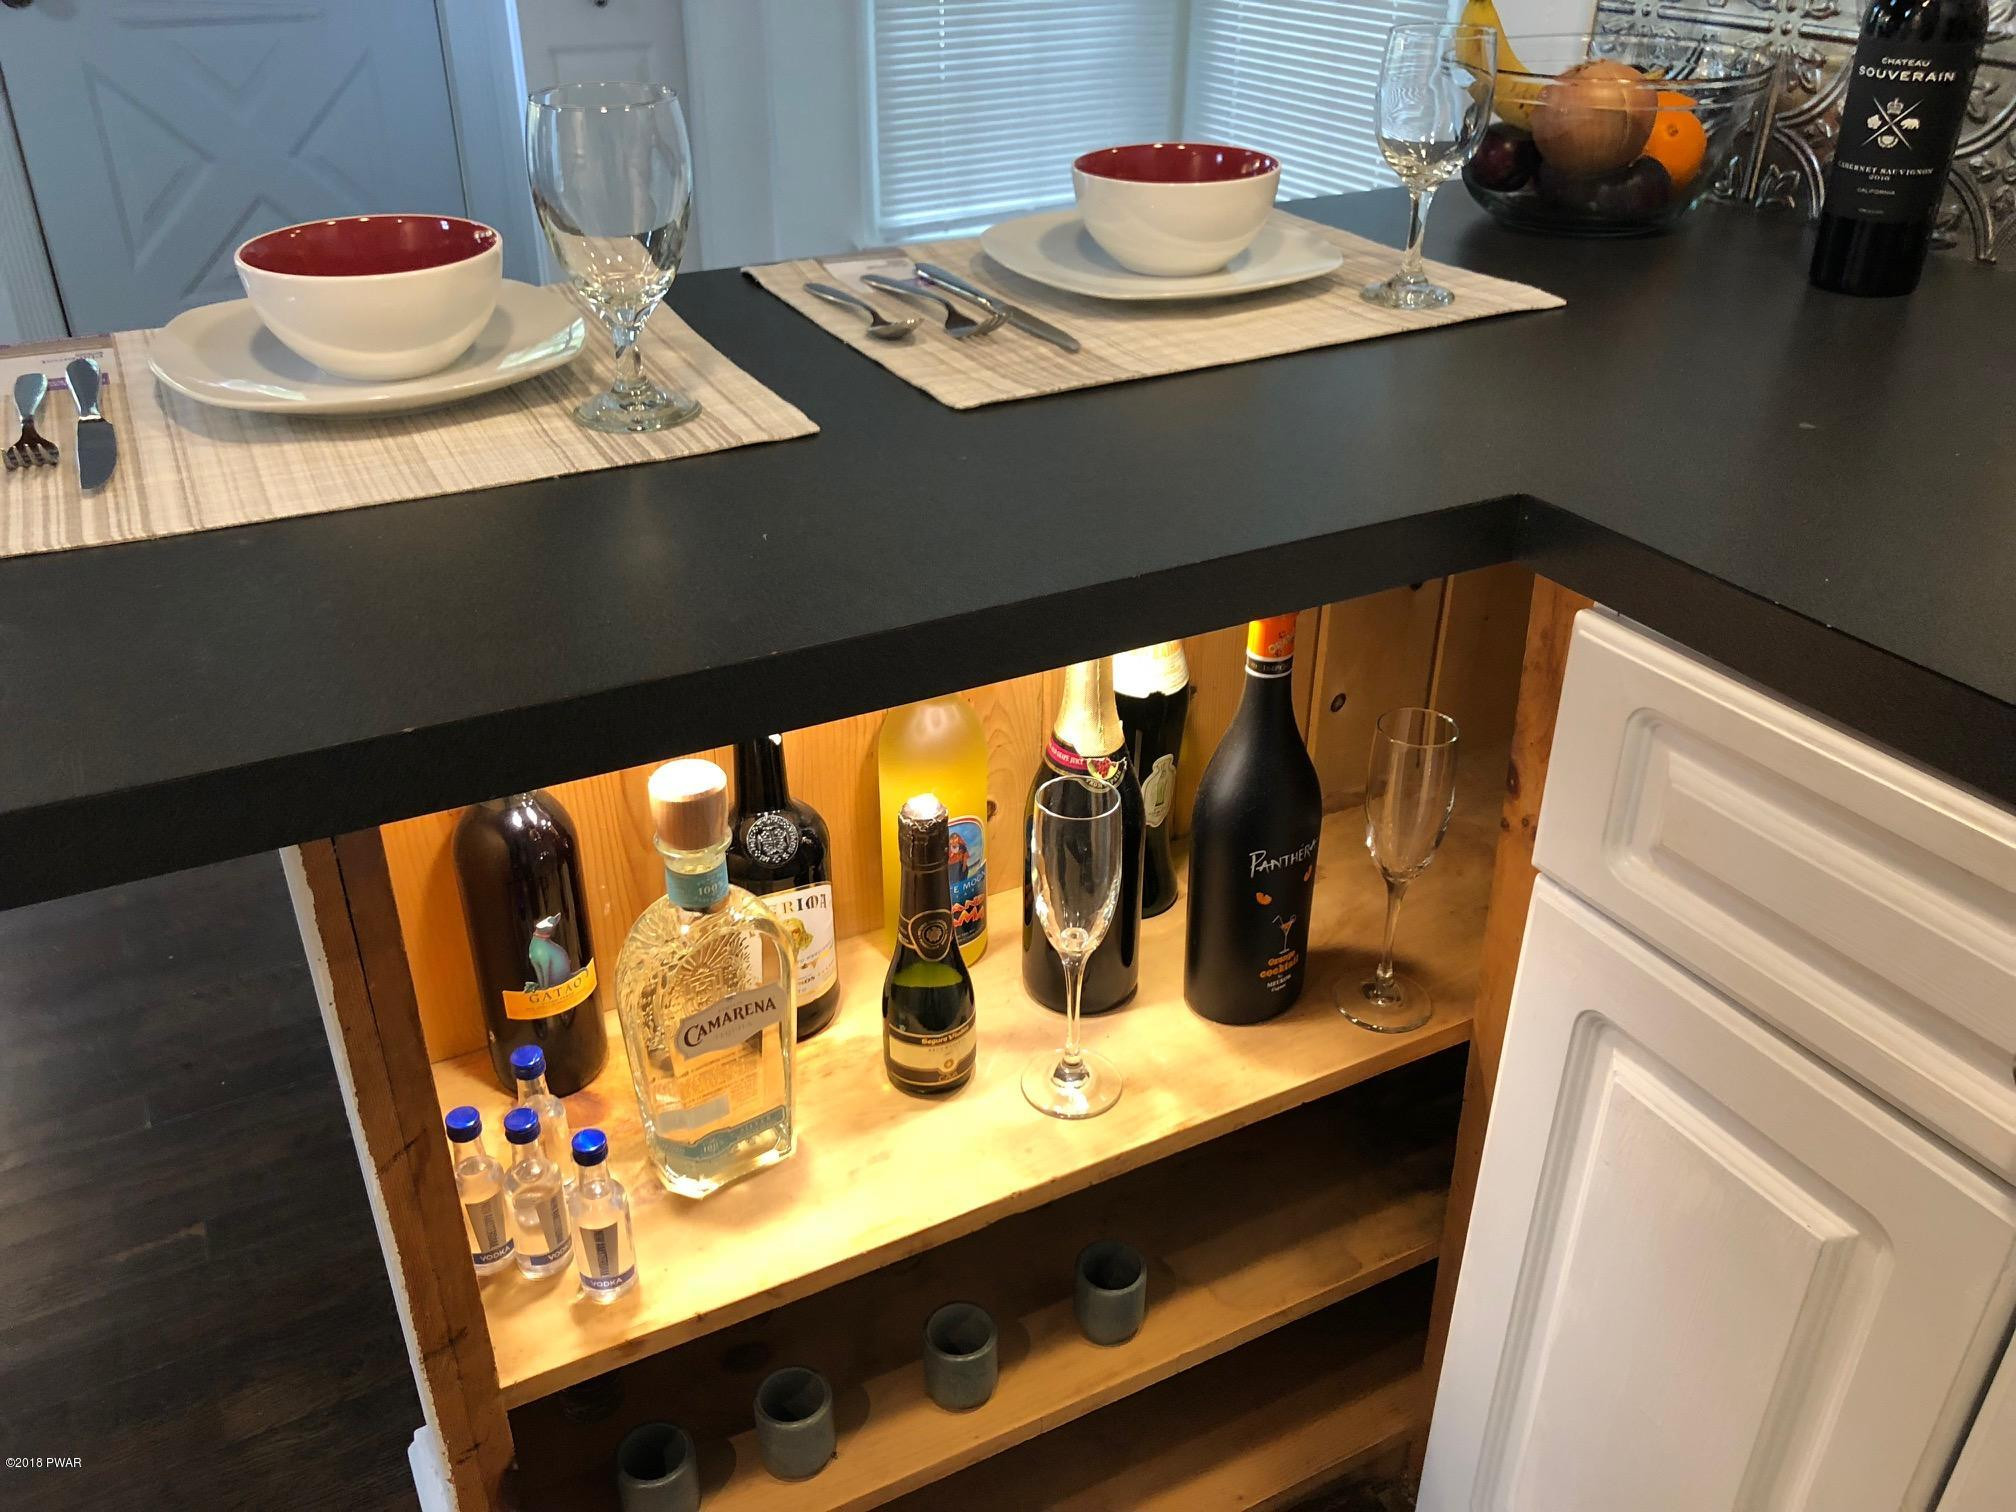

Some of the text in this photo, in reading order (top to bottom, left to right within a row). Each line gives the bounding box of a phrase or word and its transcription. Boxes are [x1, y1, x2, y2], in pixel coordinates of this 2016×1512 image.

[1881, 57, 1931, 68] CHATEAU
[1859, 65, 1956, 82] SOUVERAIN
[1838, 160, 1934, 177] CABERNET SAUVIGNON
[683, 997, 777, 1048] CAMARENA
[479, 1245, 511, 1262] VODKA
[590, 1277, 623, 1288] VODKA
